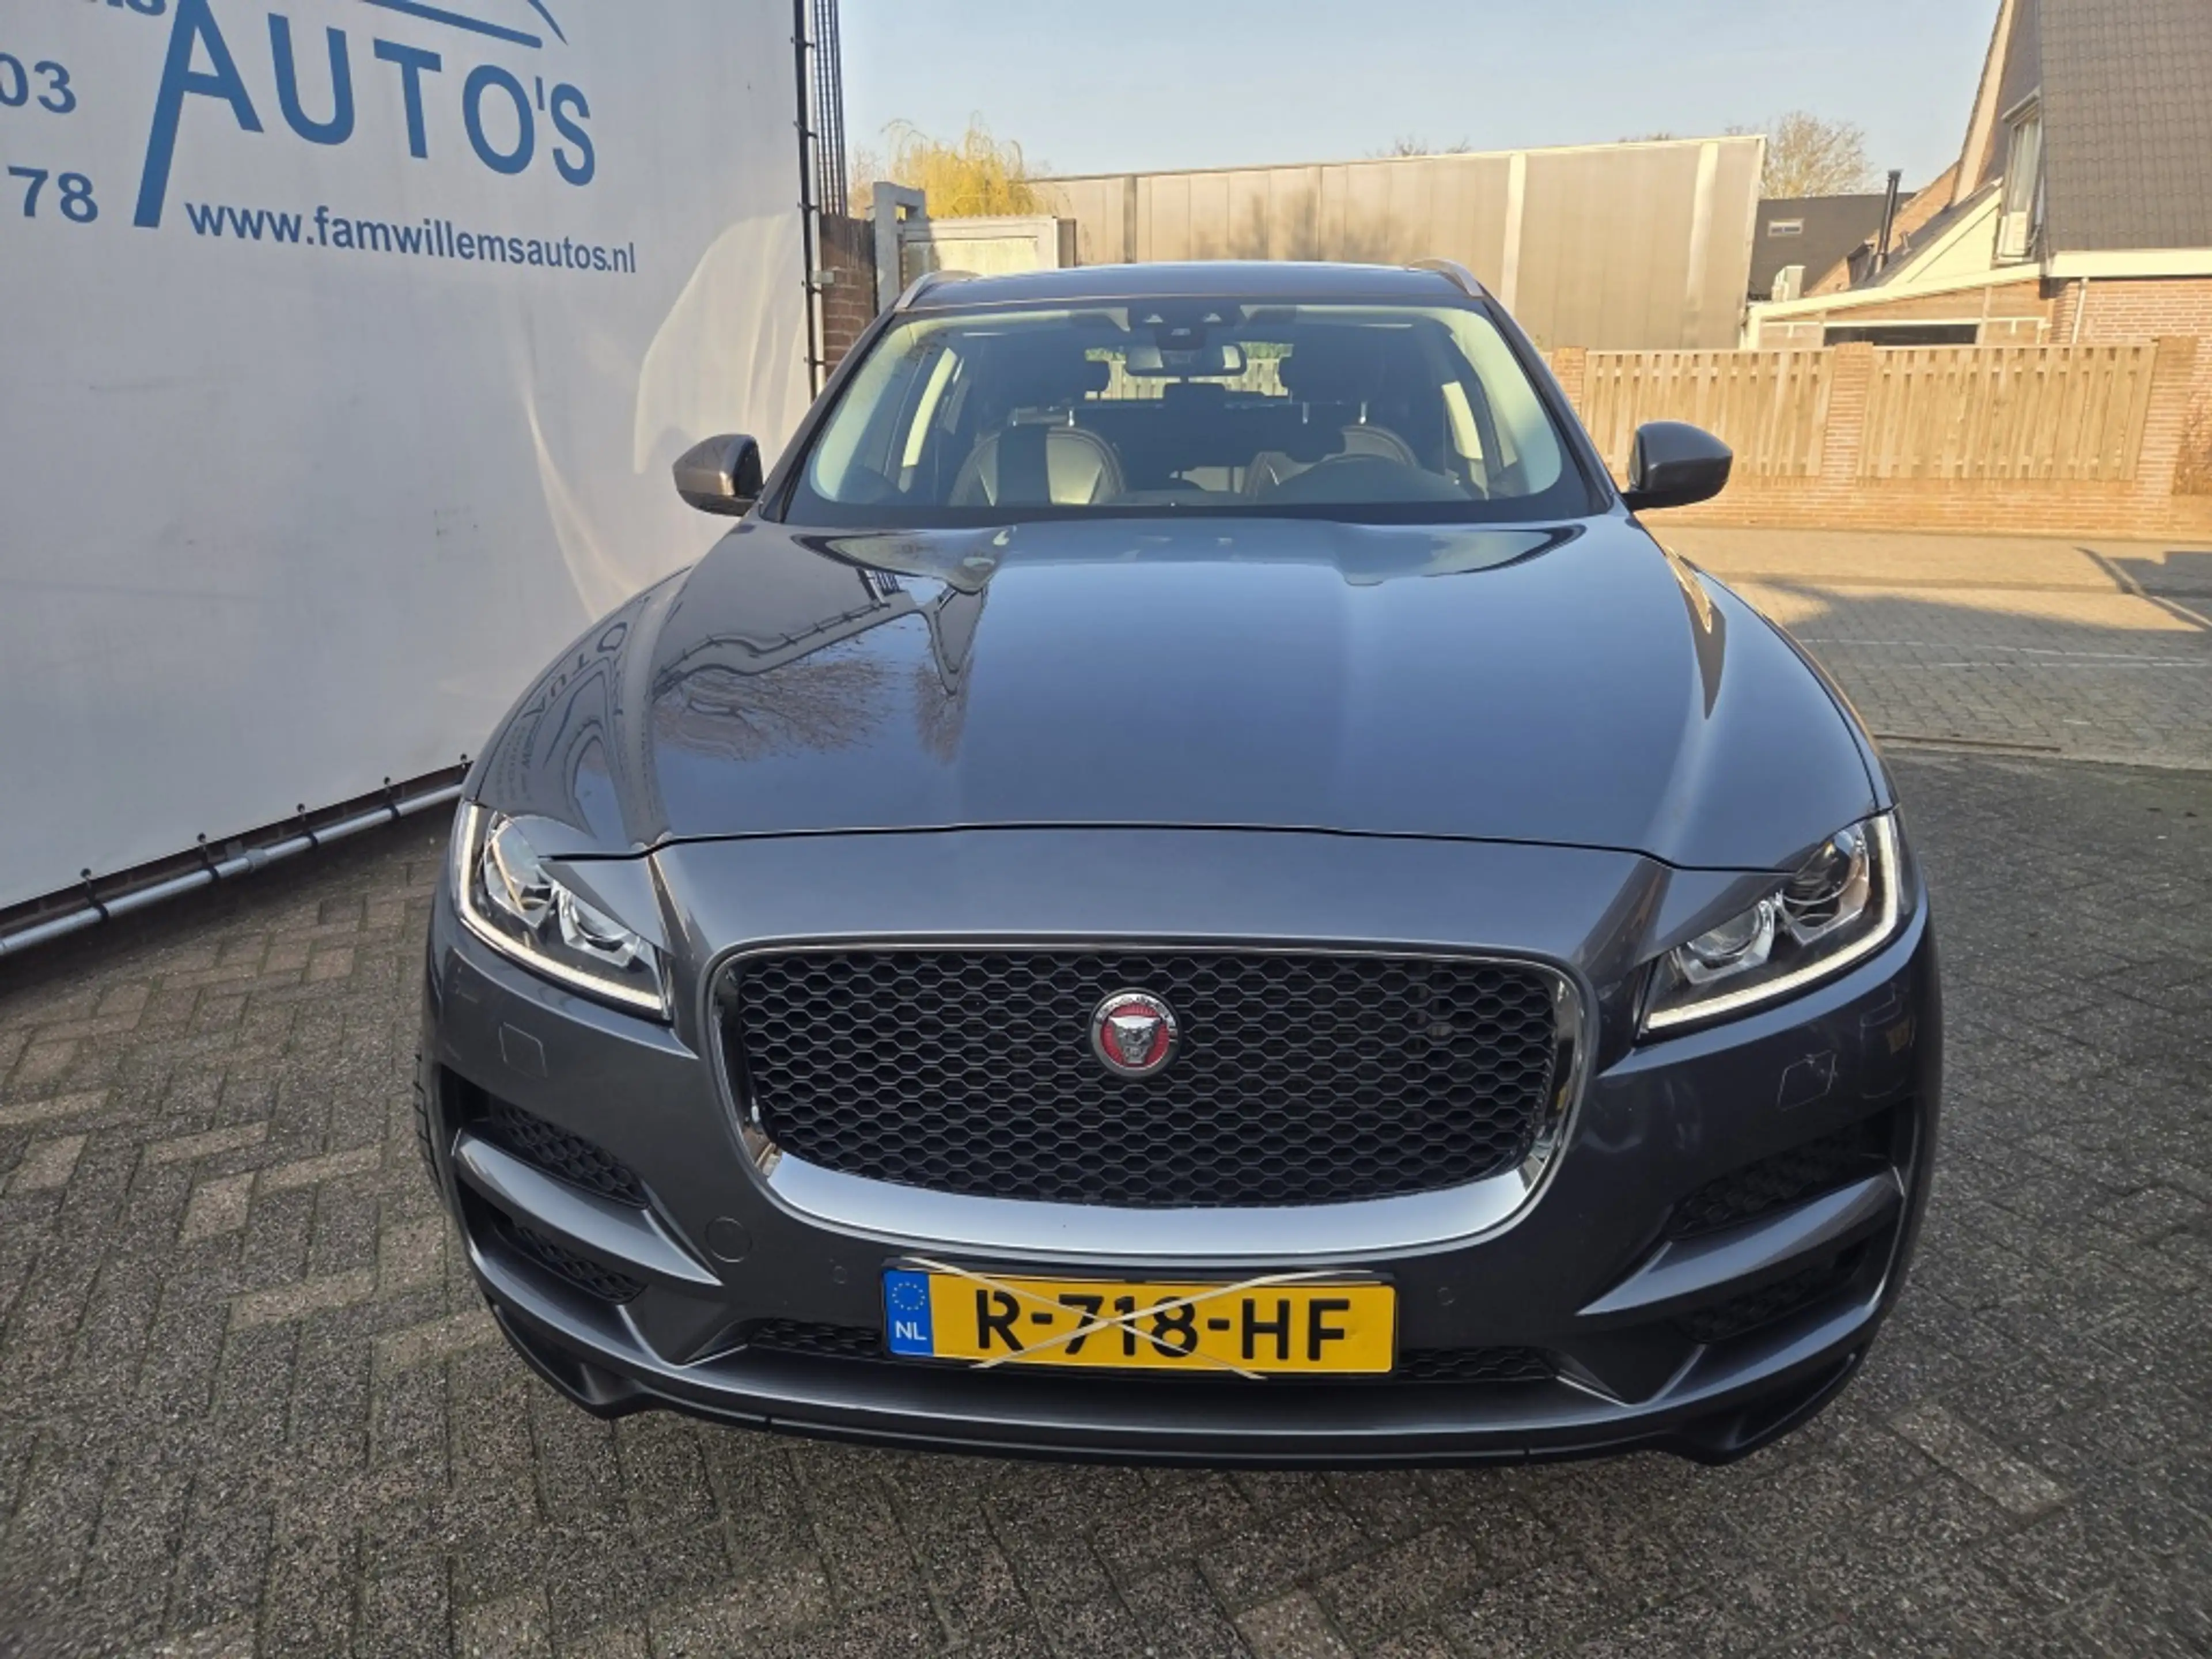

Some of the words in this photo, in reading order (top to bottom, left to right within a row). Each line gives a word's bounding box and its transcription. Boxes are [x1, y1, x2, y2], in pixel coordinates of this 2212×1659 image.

[133, 0, 596, 228] AUTO'S
[7, 165, 99, 225] 78
[185, 202, 637, 274] www.famwillemsautos.nl
[895, 1320, 927, 1341] NL
[975, 1289, 1351, 1362] R-718-HF
